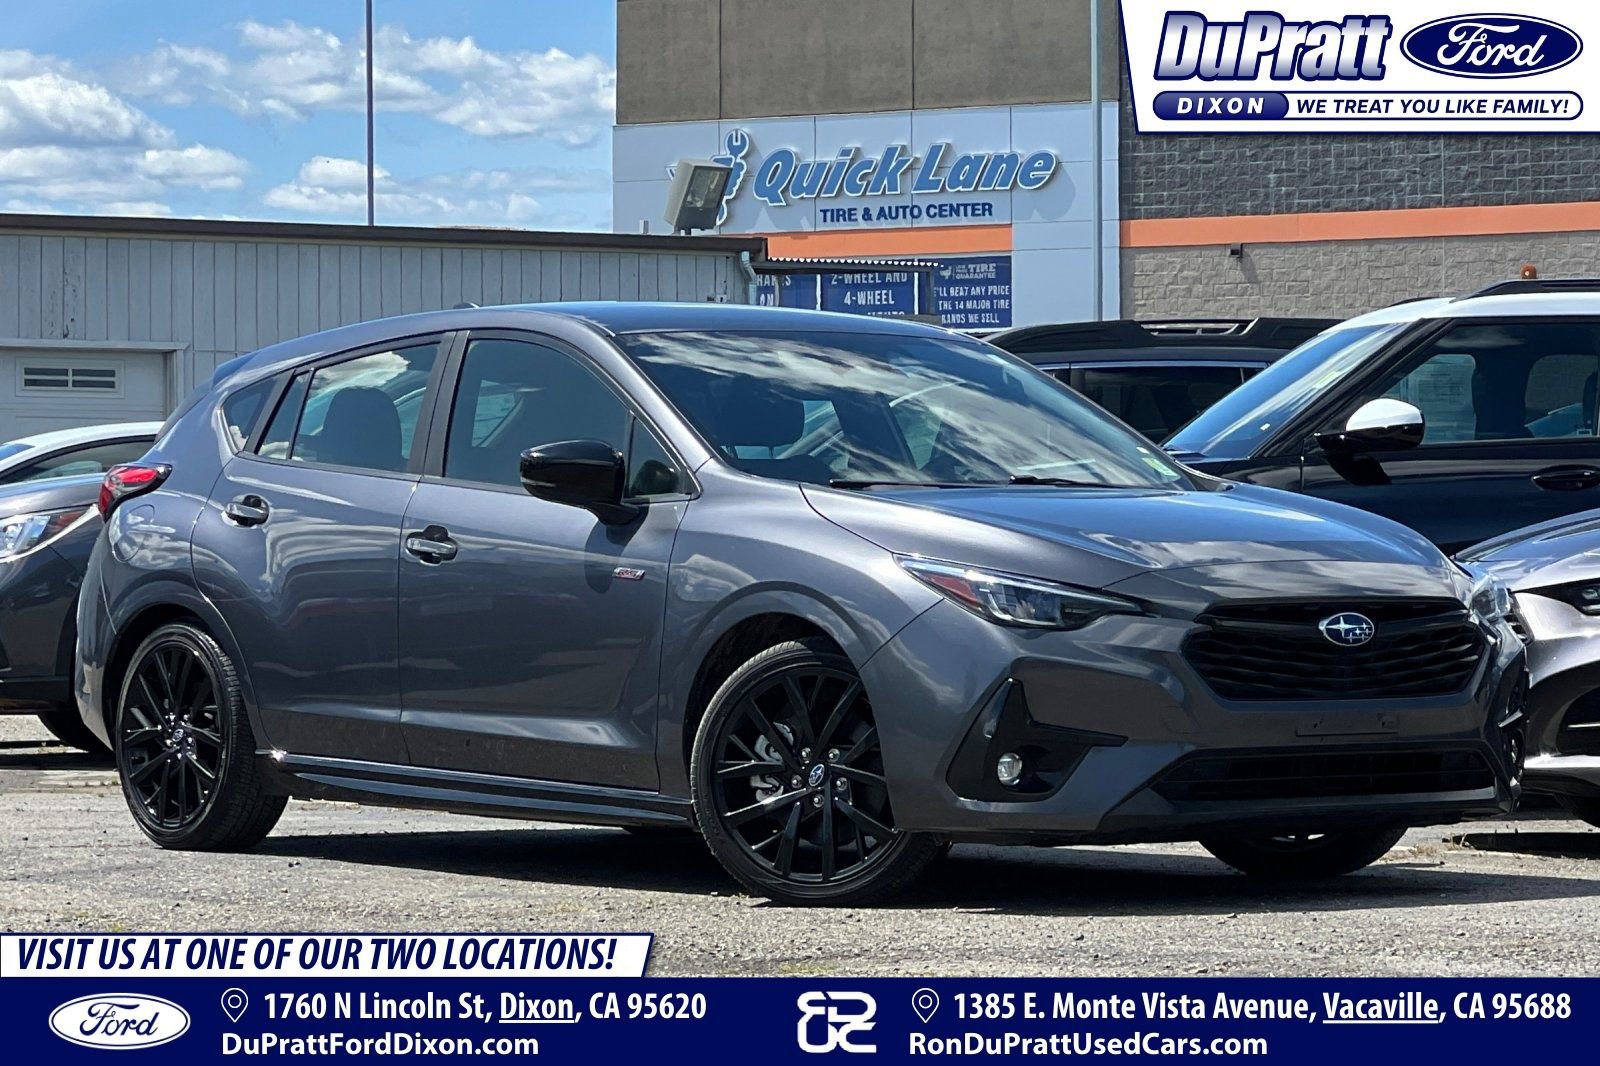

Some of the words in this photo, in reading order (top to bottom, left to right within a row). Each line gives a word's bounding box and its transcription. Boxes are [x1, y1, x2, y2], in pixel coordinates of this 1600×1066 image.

[752, 144, 914, 206] Quick
[911, 142, 1058, 194] Lane
[820, 207, 857, 223] TIRE
[861, 206, 873, 221] &
[876, 204, 923, 221] AUTO
[925, 202, 993, 219] CENTER
[968, 263, 997, 272] TIRE
[987, 285, 1010, 296] PRICE
[843, 290, 895, 305] 4-WHEEL
[955, 300, 964, 310] 14
[965, 299, 991, 310] MAJOR
[993, 299, 1010, 309] TIRE
[968, 313, 979, 323] WE
[981, 312, 1000, 323] SELL
